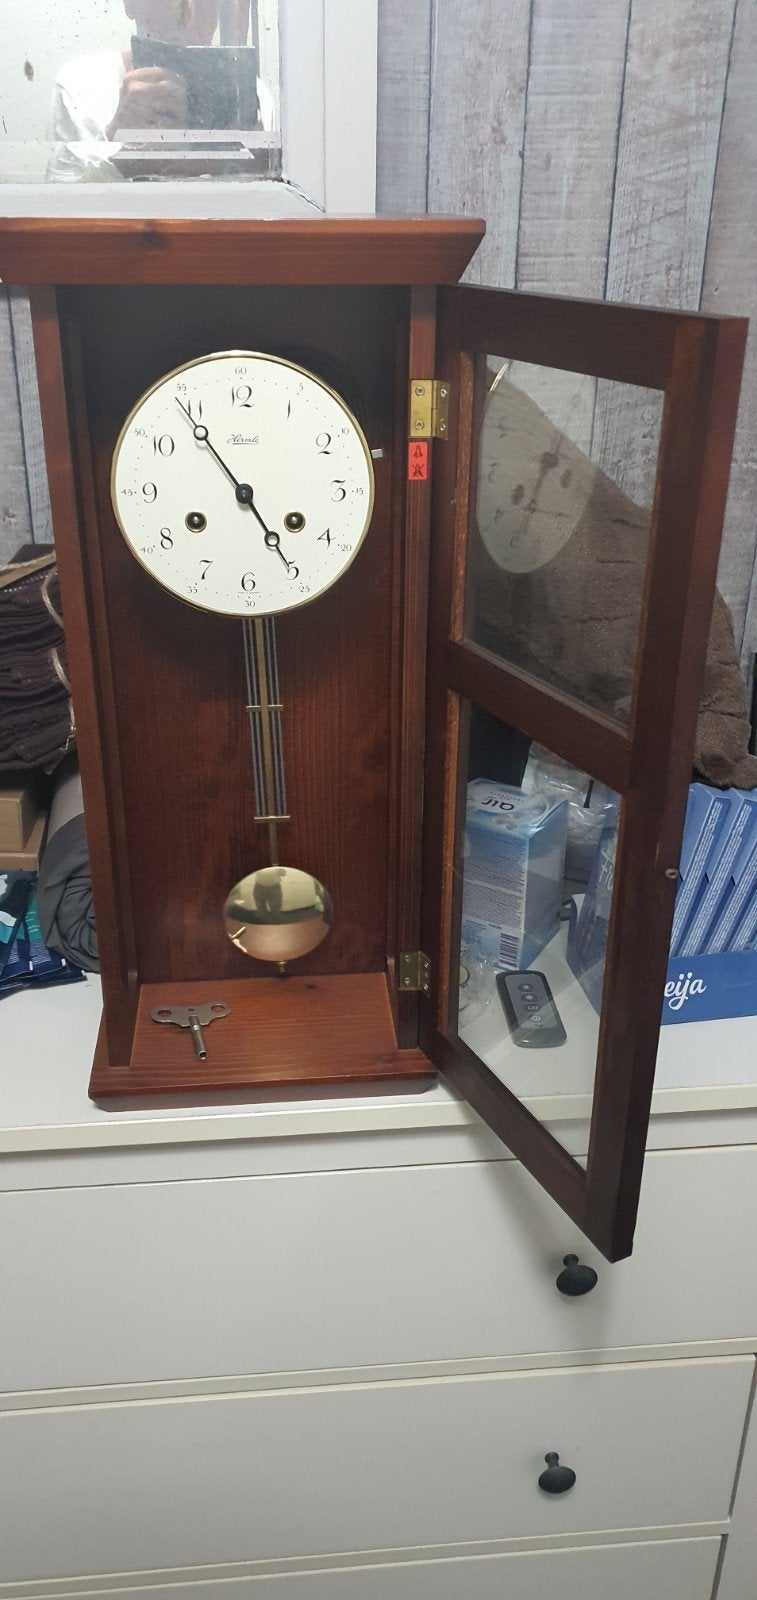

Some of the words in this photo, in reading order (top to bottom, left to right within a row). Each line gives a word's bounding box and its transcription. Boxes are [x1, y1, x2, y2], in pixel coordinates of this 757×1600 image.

[234, 366, 247, 375] 60
[176, 382, 187, 391] 55
[298, 382, 304, 391] 5
[231, 384, 254, 407] 12
[133, 428, 146, 437] 50
[341, 427, 350, 436] 10
[153, 434, 175, 457] 10
[315, 432, 335, 455] 2
[121, 488, 133, 497] 45
[142, 481, 158, 504] 9
[330, 479, 347, 502] 3
[356, 487, 365, 496] 15
[160, 527, 174, 550] 8
[316, 527, 336, 549] 4
[140, 546, 154, 555] 40
[341, 544, 353, 552] 20
[199, 559, 214, 580] 7
[285, 559, 300, 581] 5
[241, 571, 256, 592] 6
[244, 600, 256, 608] 30
